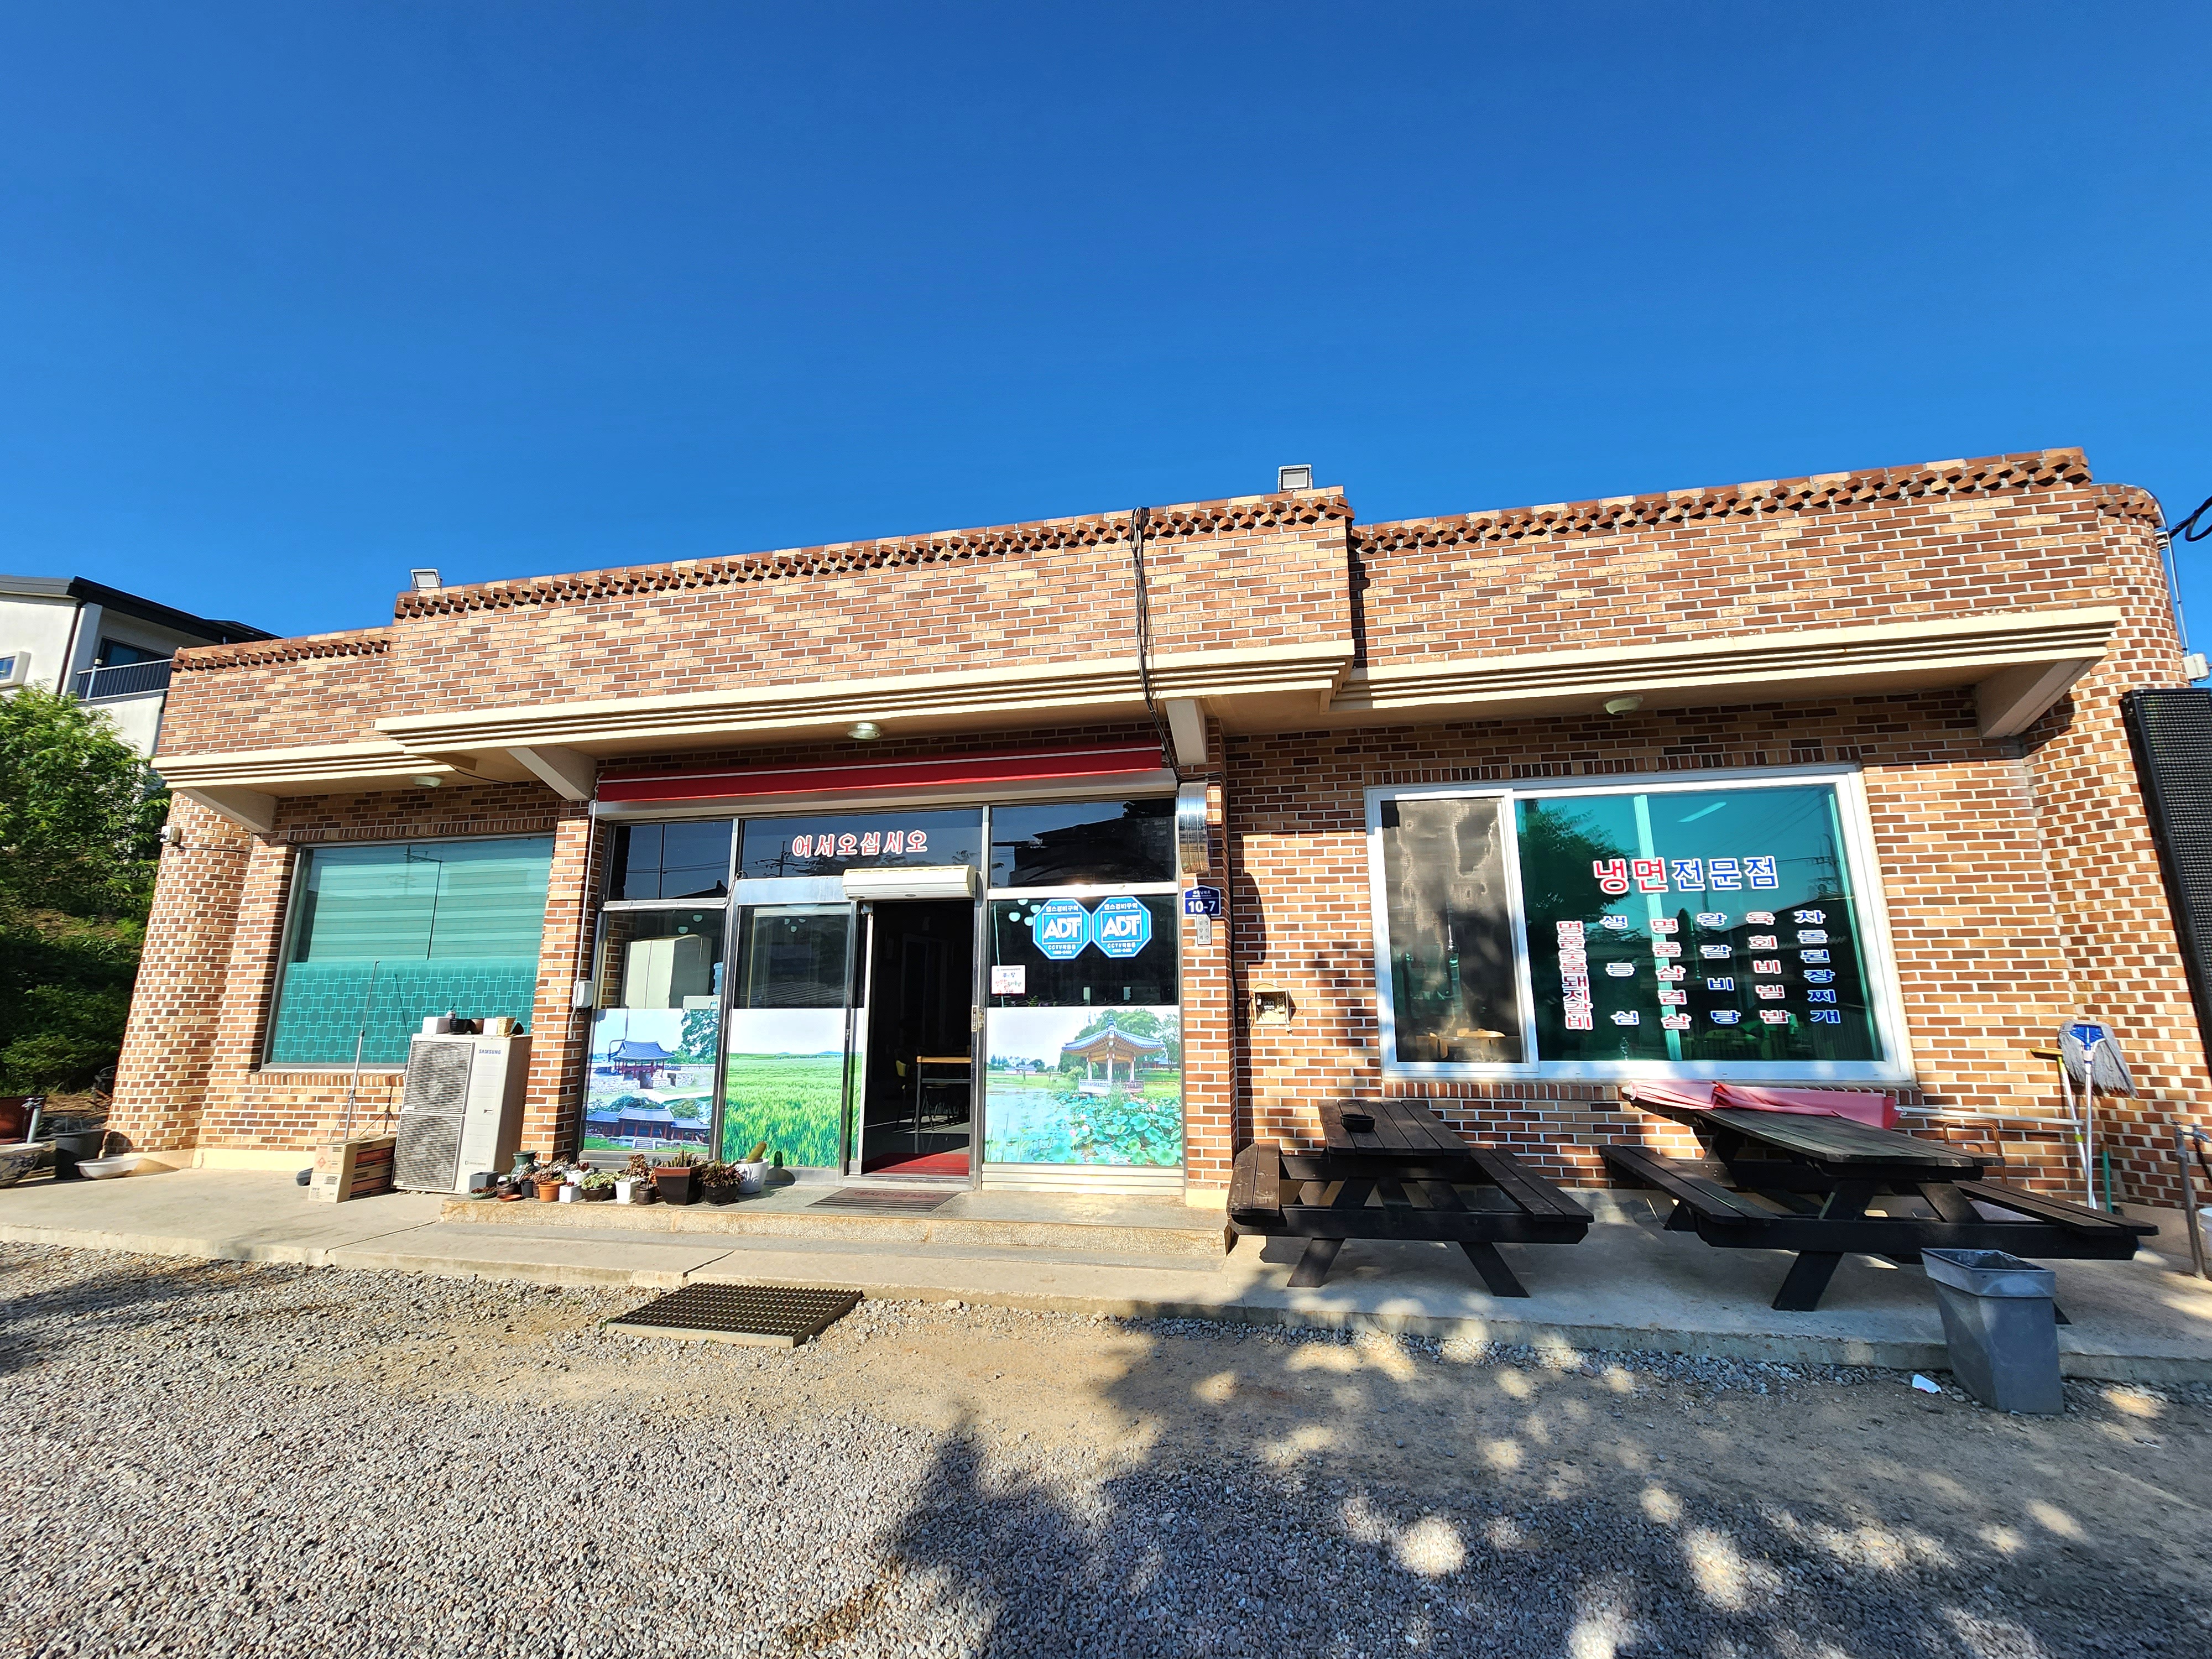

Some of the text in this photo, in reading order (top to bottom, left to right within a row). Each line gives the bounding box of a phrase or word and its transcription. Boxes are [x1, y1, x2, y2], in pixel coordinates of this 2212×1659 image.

[792, 830, 928, 858] 어서오십시오
[1044, 917, 1081, 938] ADT
[1102, 915, 1140, 937] ADT
[1188, 900, 1215, 912] 10-7
[1556, 921, 1593, 1030] 명품숯불돼지갈비
[1599, 915, 1640, 1025] 생등심
[1651, 918, 1692, 1029] 명품삼겹살
[1697, 912, 1741, 1024] 왕갈비탕
[1746, 911, 1790, 1024] 육회비빔밥
[1794, 910, 1841, 1024] 차돌된장찌개
